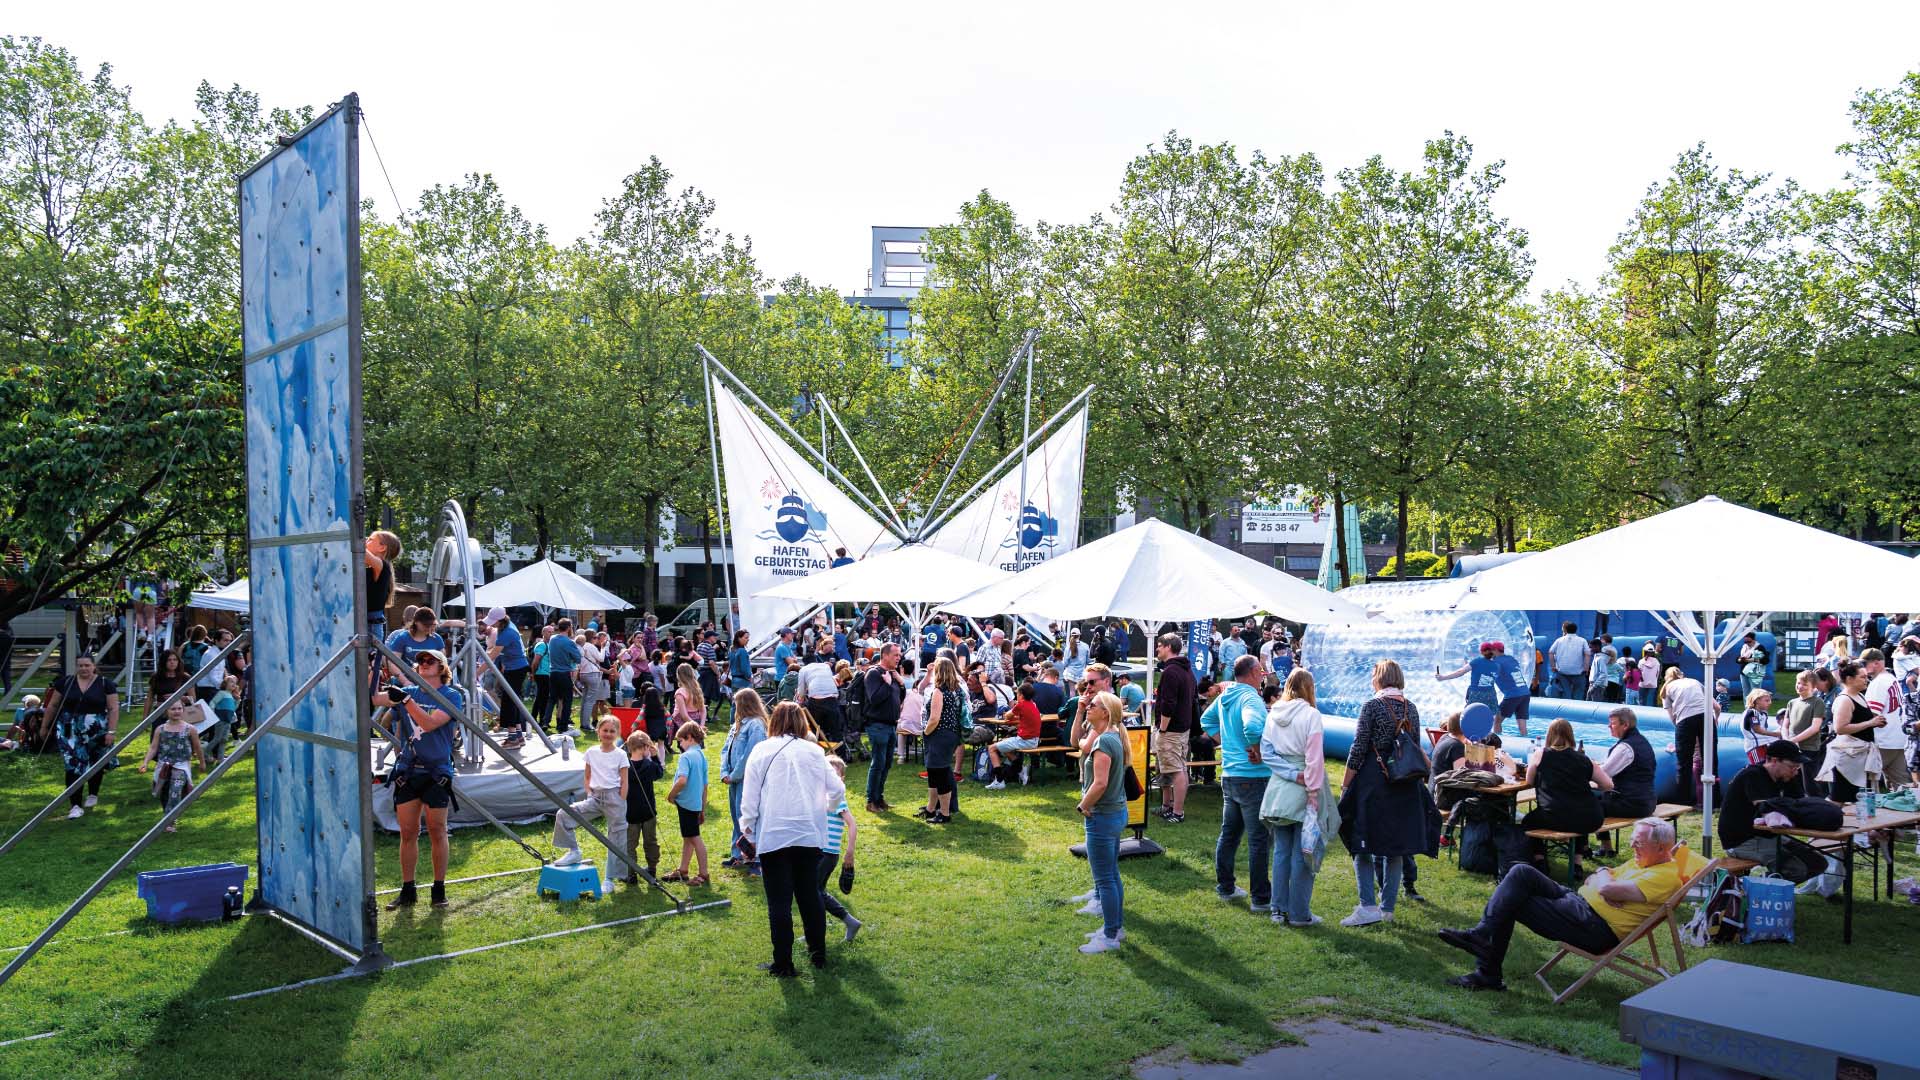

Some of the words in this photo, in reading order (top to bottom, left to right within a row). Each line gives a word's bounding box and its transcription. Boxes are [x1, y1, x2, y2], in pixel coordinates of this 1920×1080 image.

[1261, 523, 1272, 531] 25
[1275, 523, 1287, 531] 38
[1289, 523, 1300, 531] 47
[773, 545, 809, 557] HAFEN
[754, 556, 826, 569] GEBURTSTAG
[772, 568, 809, 576] HAMBURG
[1751, 899, 1793, 911] SNOW
